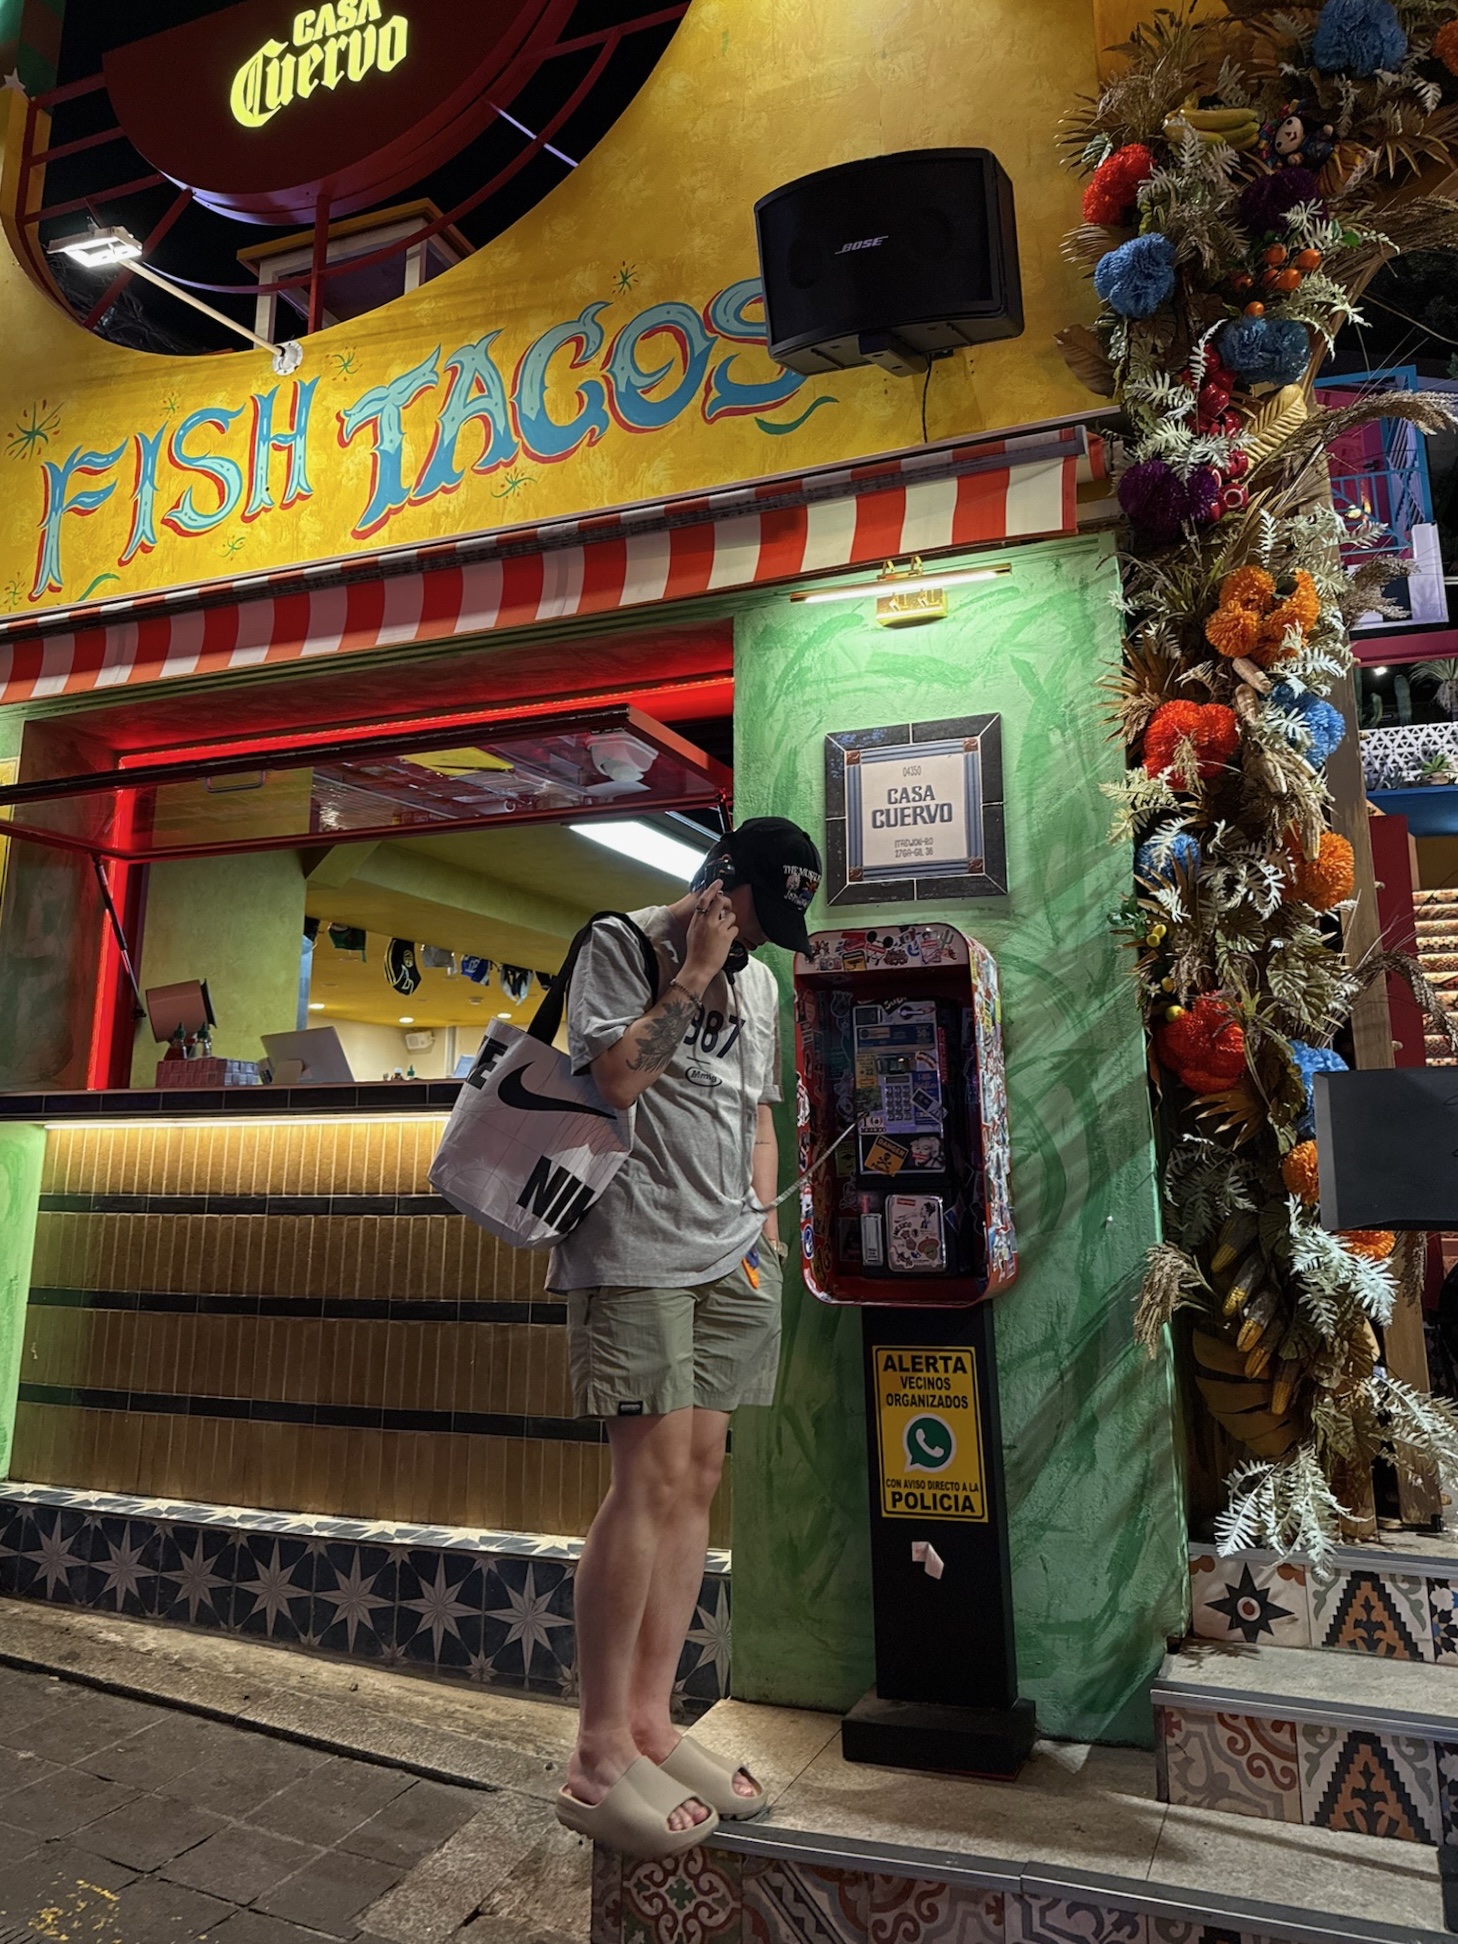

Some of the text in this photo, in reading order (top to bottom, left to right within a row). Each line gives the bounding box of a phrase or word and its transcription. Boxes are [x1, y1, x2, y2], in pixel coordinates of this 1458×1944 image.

[292, 0, 382, 47] CASA
[230, 14, 408, 128] Cuervo
[834, 235, 889, 255] BOSE
[28, 276, 808, 602] FISH TACOS
[902, 765, 922, 777] 04350
[887, 784, 936, 805] CASA
[871, 802, 953, 829] CUERVO
[882, 1353, 968, 1375] ALERTA
[900, 1375, 952, 1391] VECINOS
[885, 1392, 969, 1409] ORGANIZADOS
[885, 1478, 980, 1493] CON AVISO DIRECTO A LA
[890, 1491, 977, 1514] POLICIA
